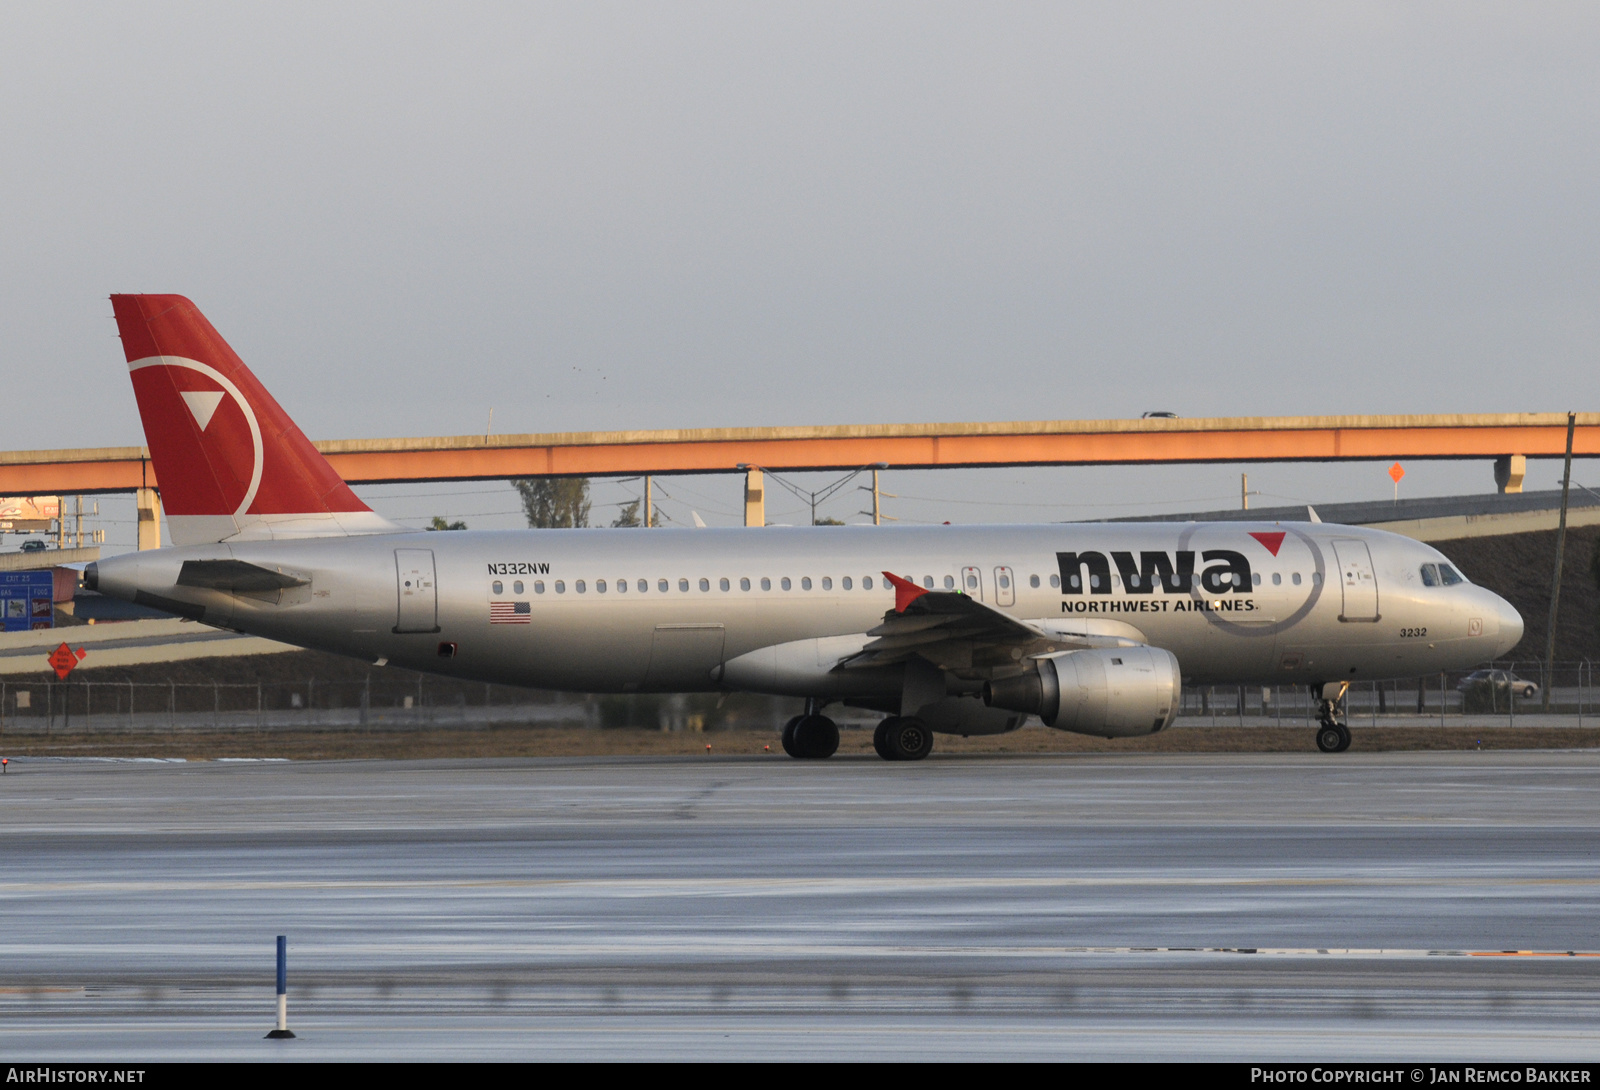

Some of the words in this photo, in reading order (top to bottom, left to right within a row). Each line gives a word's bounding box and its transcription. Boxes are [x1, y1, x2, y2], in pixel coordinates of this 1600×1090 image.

[487, 563, 550, 575] N332NW
[1056, 550, 1253, 595] nwa
[1061, 600, 1169, 613] NORTHWEST
[1400, 627, 1427, 638] 3232
